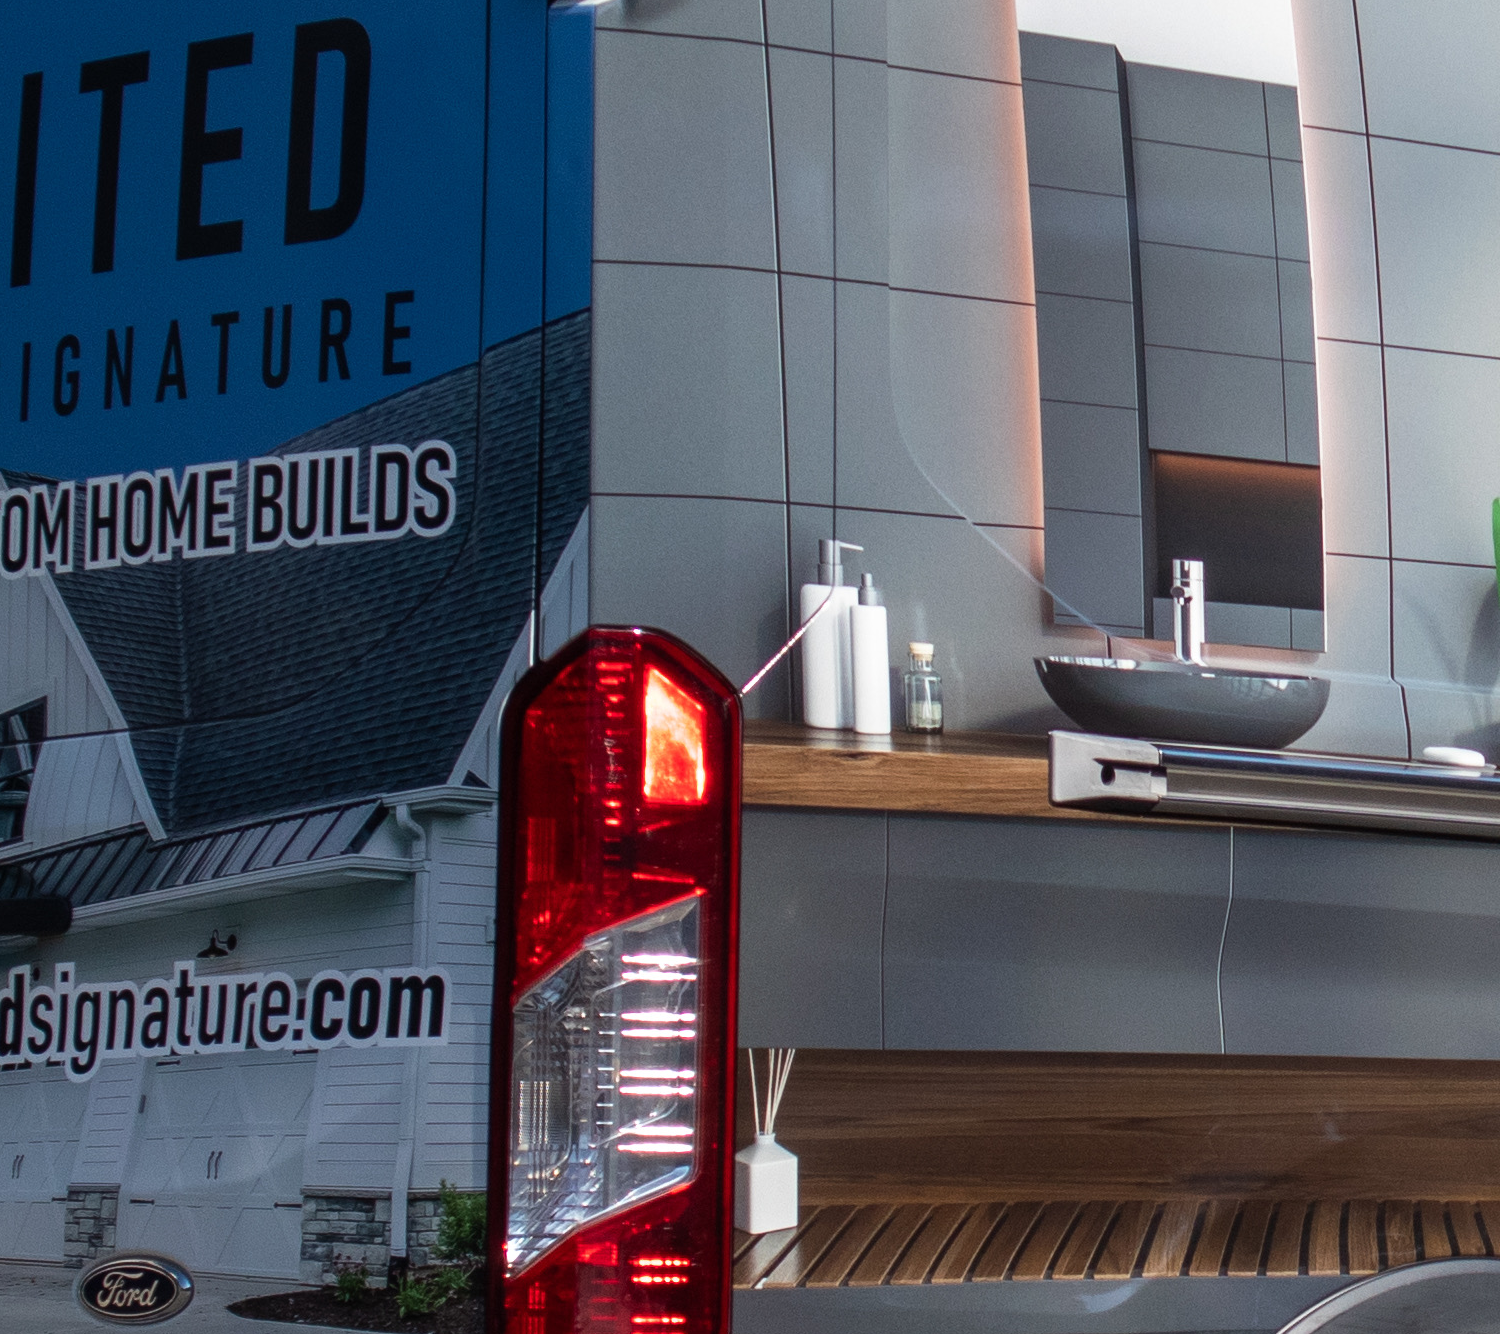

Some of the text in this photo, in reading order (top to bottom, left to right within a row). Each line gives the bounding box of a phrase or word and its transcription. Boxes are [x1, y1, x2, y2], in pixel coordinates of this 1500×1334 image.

[84, 460, 238, 569] HOME
[248, 438, 458, 550] BUILDS
[97, 1271, 159, 1308] Ford
